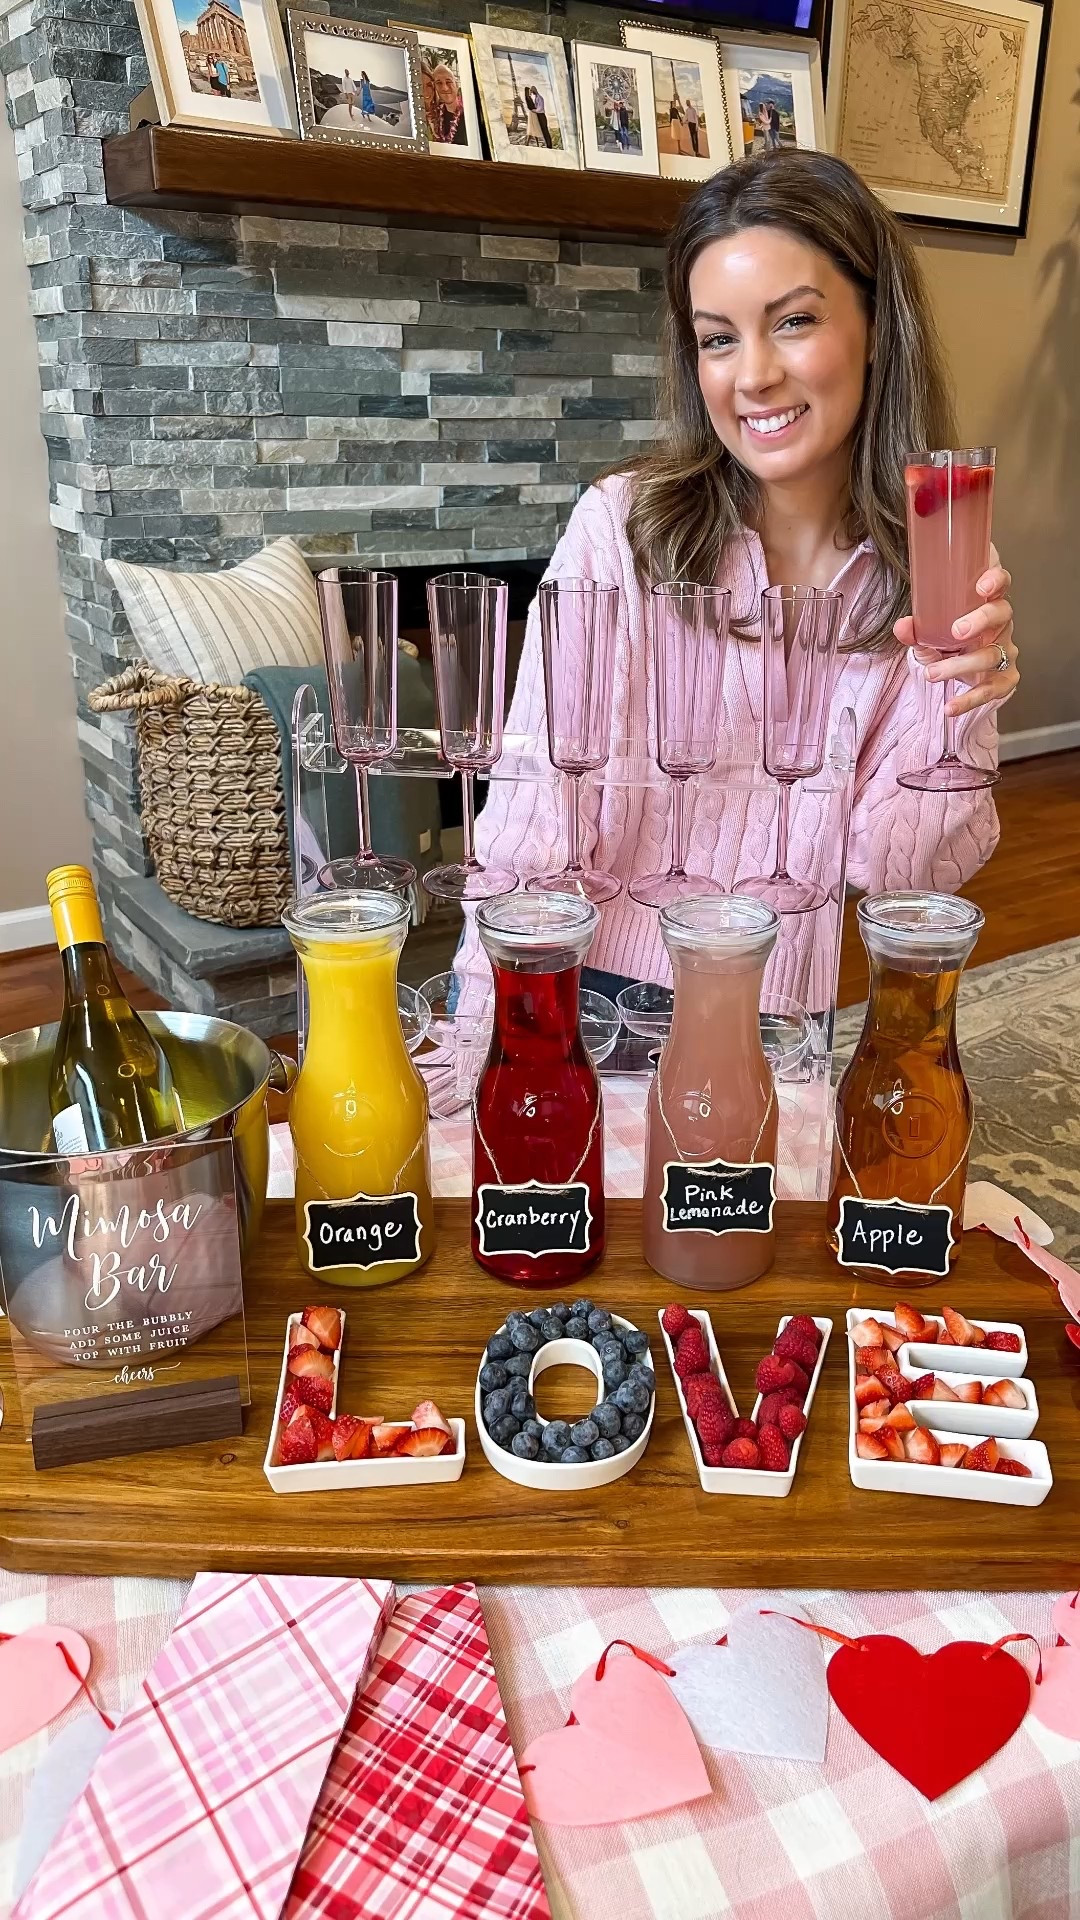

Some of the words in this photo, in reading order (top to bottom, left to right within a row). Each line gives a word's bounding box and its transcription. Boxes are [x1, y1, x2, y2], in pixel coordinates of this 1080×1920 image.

[684, 1184, 735, 1204] Pink
[486, 1206, 581, 1244] Cranberry
[669, 1198, 765, 1222] Lemonade
[28, 1193, 203, 1262] Mimosa
[319, 1221, 403, 1251] Orange
[851, 1219, 923, 1253] Apple
[84, 1250, 179, 1311] Bar
[63, 1325, 101, 1338] POUR
[107, 1320, 135, 1331] THE
[142, 1311, 193, 1327] BUBBLY
[69, 1338, 97, 1350] ADD
[104, 1331, 142, 1345] SOME
[150, 1324, 190, 1338] JUICE
[73, 1350, 100, 1362] TOP
[107, 1344, 142, 1357] WITH
[149, 1337, 189, 1351] FRUIT
[263, 1301, 1053, 1506] LOVE
